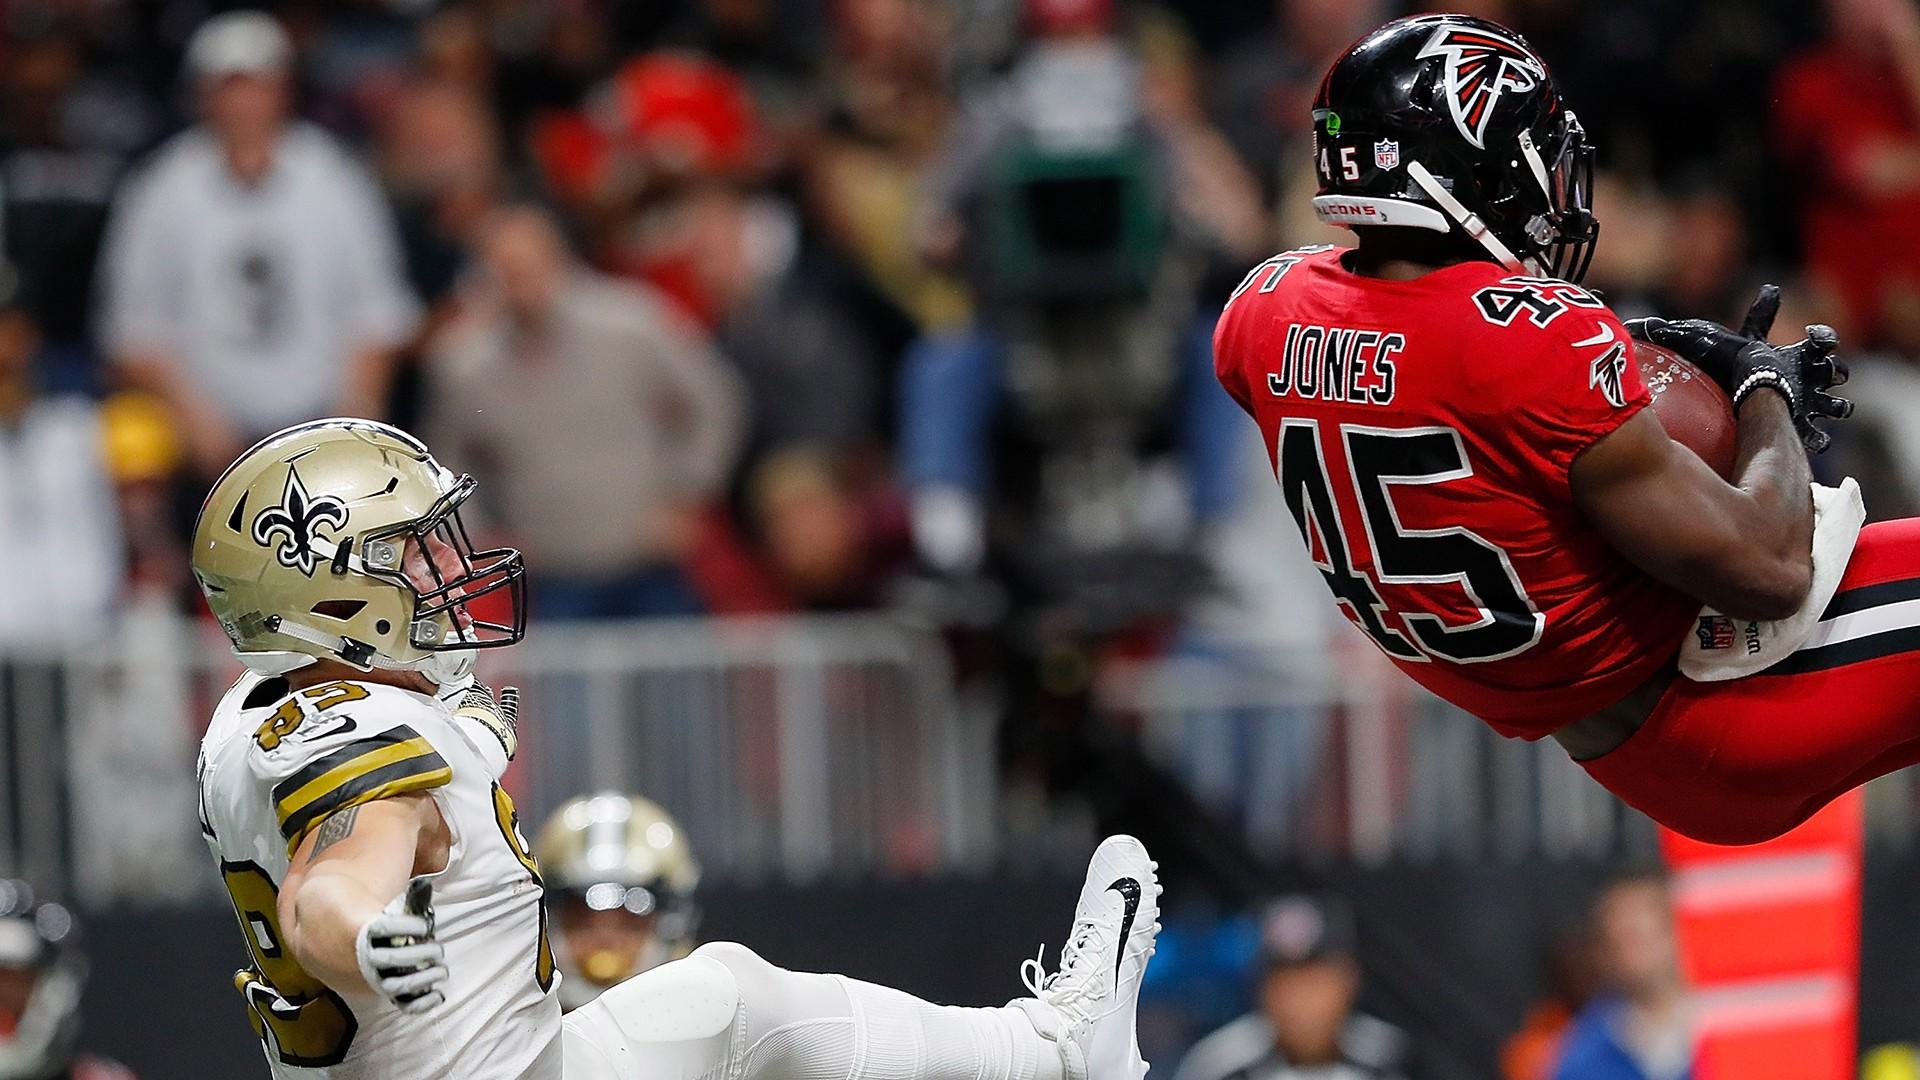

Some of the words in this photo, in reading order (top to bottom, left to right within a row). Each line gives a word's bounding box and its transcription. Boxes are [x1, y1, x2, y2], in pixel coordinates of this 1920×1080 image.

[1376, 153, 1396, 165] NFL
[1267, 324, 1406, 406] JONES
[1277, 417, 1547, 665] 45
[1744, 620, 1761, 655] Wils
